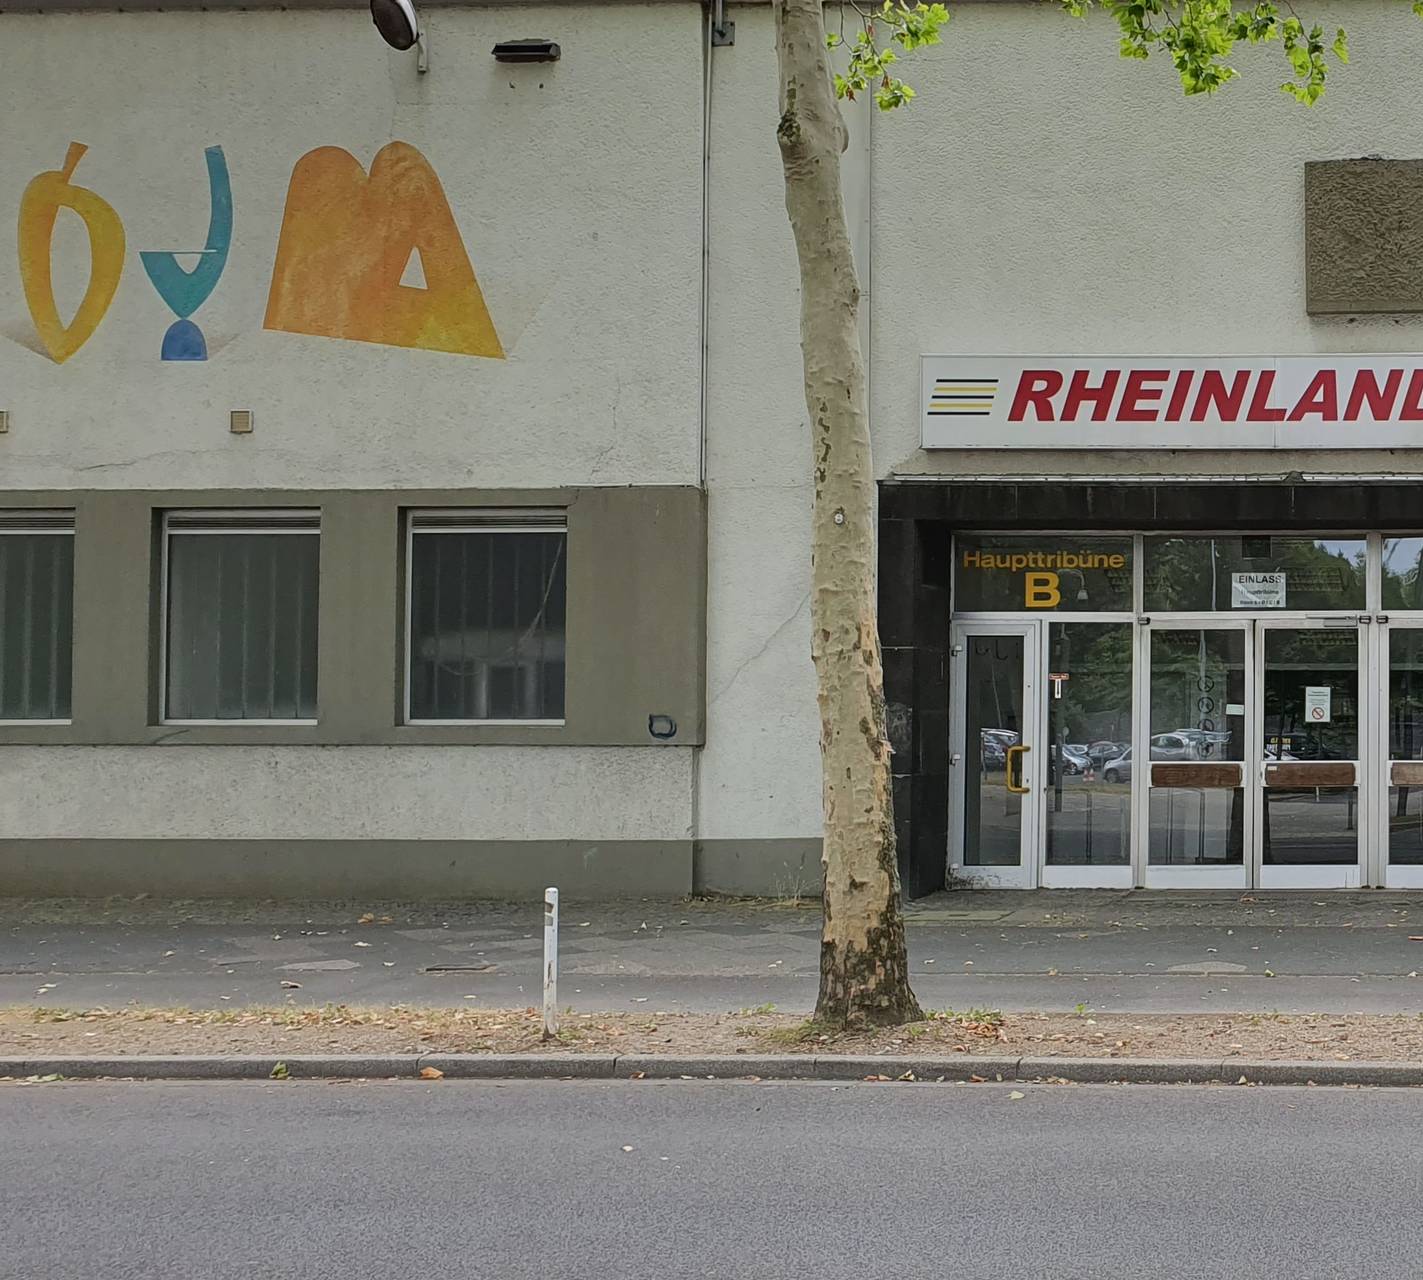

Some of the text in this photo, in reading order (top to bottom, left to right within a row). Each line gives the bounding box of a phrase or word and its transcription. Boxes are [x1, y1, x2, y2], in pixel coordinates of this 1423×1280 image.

[963, 550, 1125, 571] Haupttribüne
[1025, 571, 1061, 608] B
[1238, 575, 1282, 584] EINLASS
